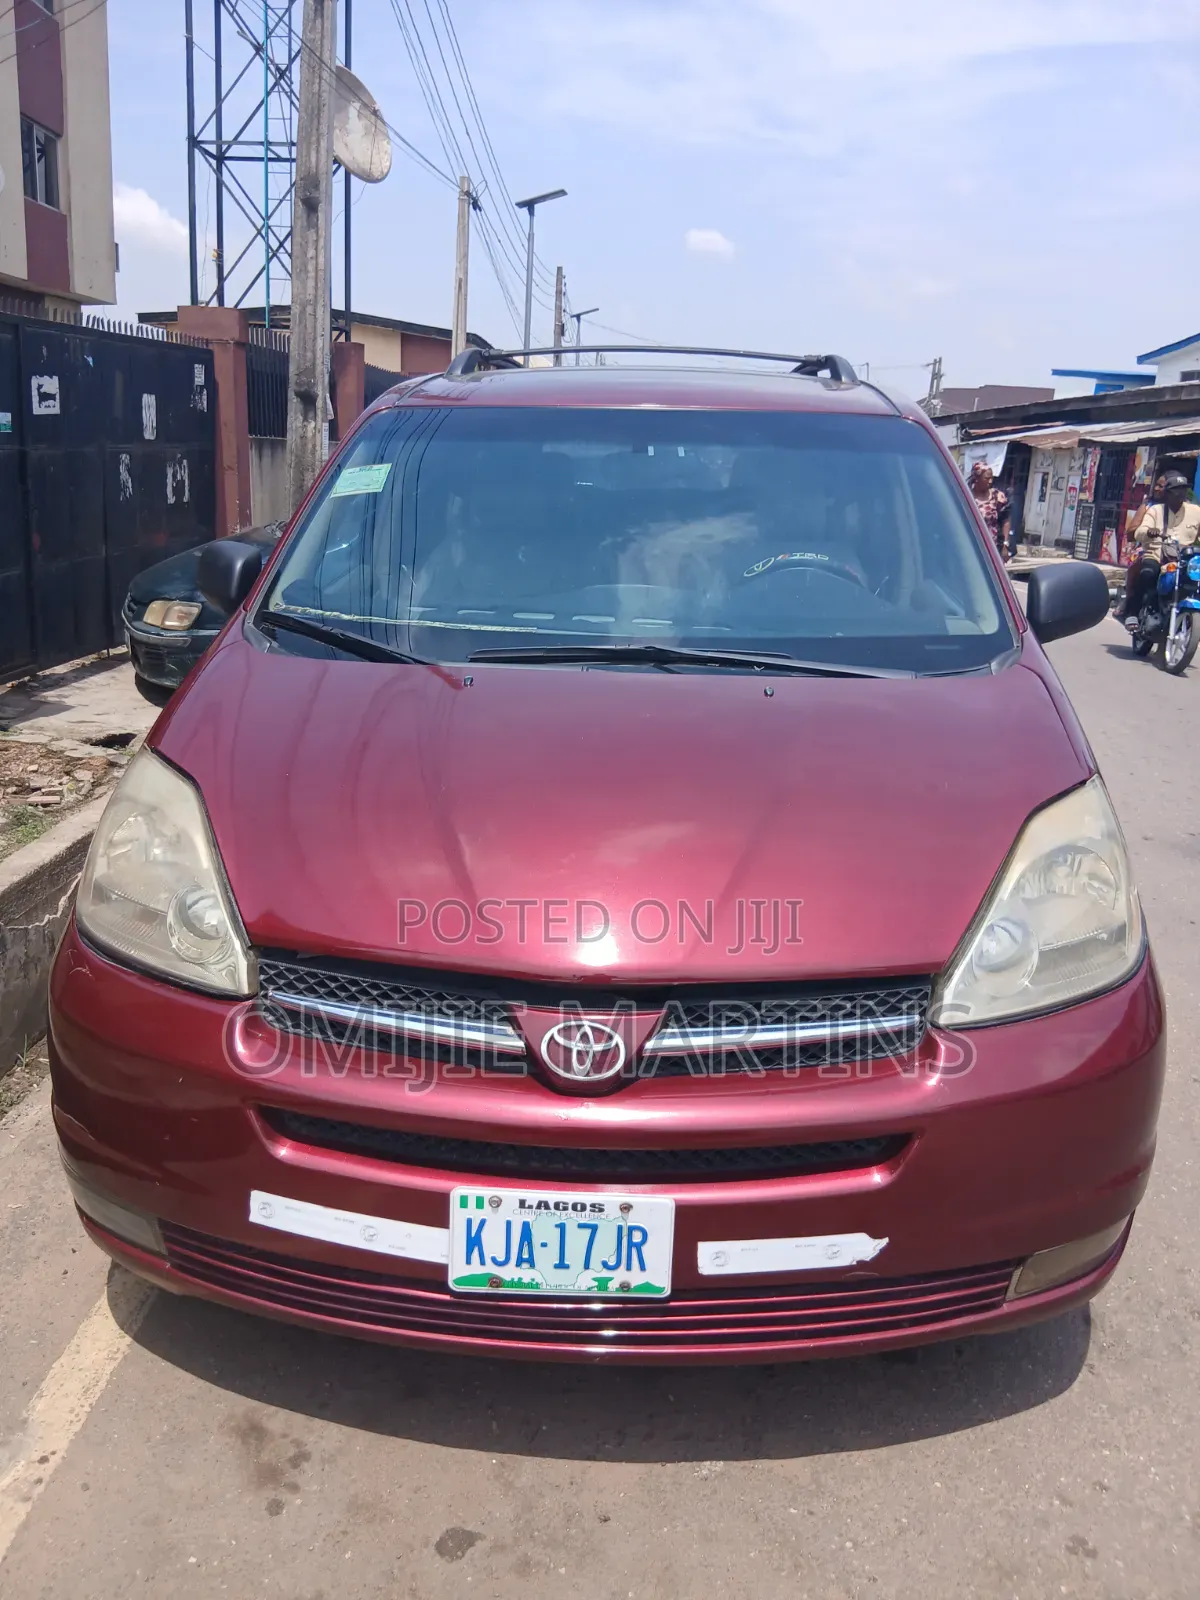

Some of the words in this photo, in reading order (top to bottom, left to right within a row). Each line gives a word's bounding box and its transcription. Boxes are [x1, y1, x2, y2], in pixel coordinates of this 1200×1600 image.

[518, 1199, 606, 1213] LAGOS
[512, 1209, 542, 1217] CENTRE
[559, 1211, 612, 1220] EXCELLENCE
